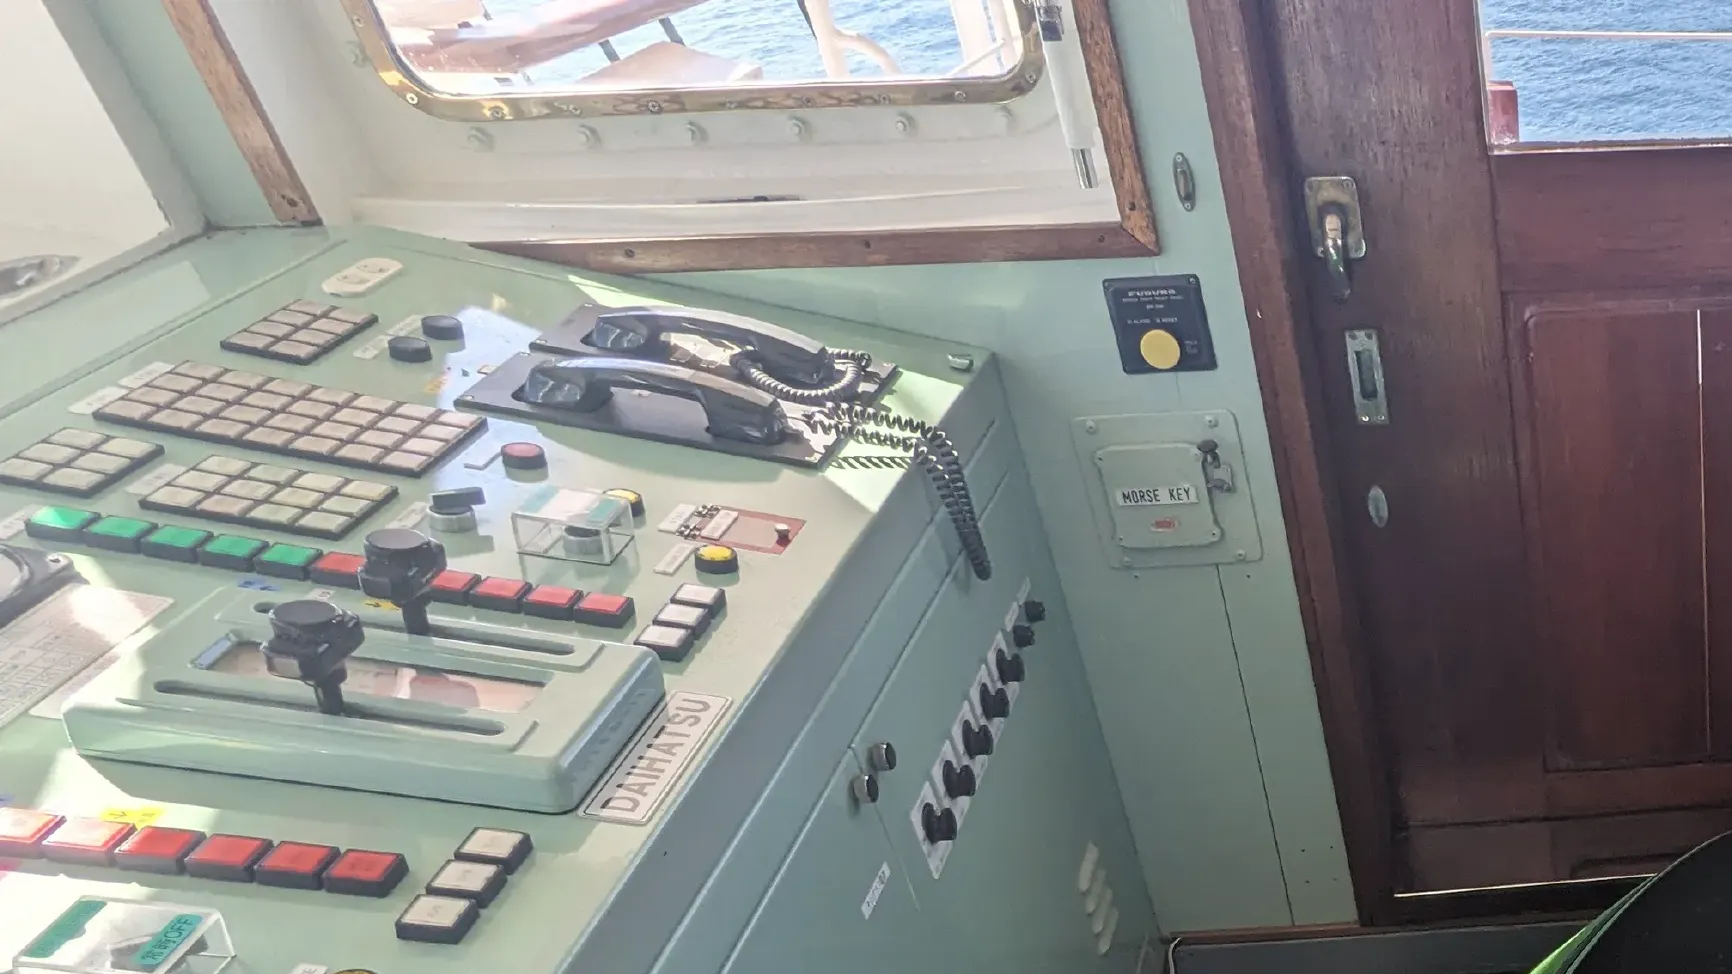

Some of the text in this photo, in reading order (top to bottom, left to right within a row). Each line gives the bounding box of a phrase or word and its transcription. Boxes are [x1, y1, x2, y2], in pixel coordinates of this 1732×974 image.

[1121, 487, 1190, 504] MORSE KEY
[600, 698, 711, 813] DAIHATSU
